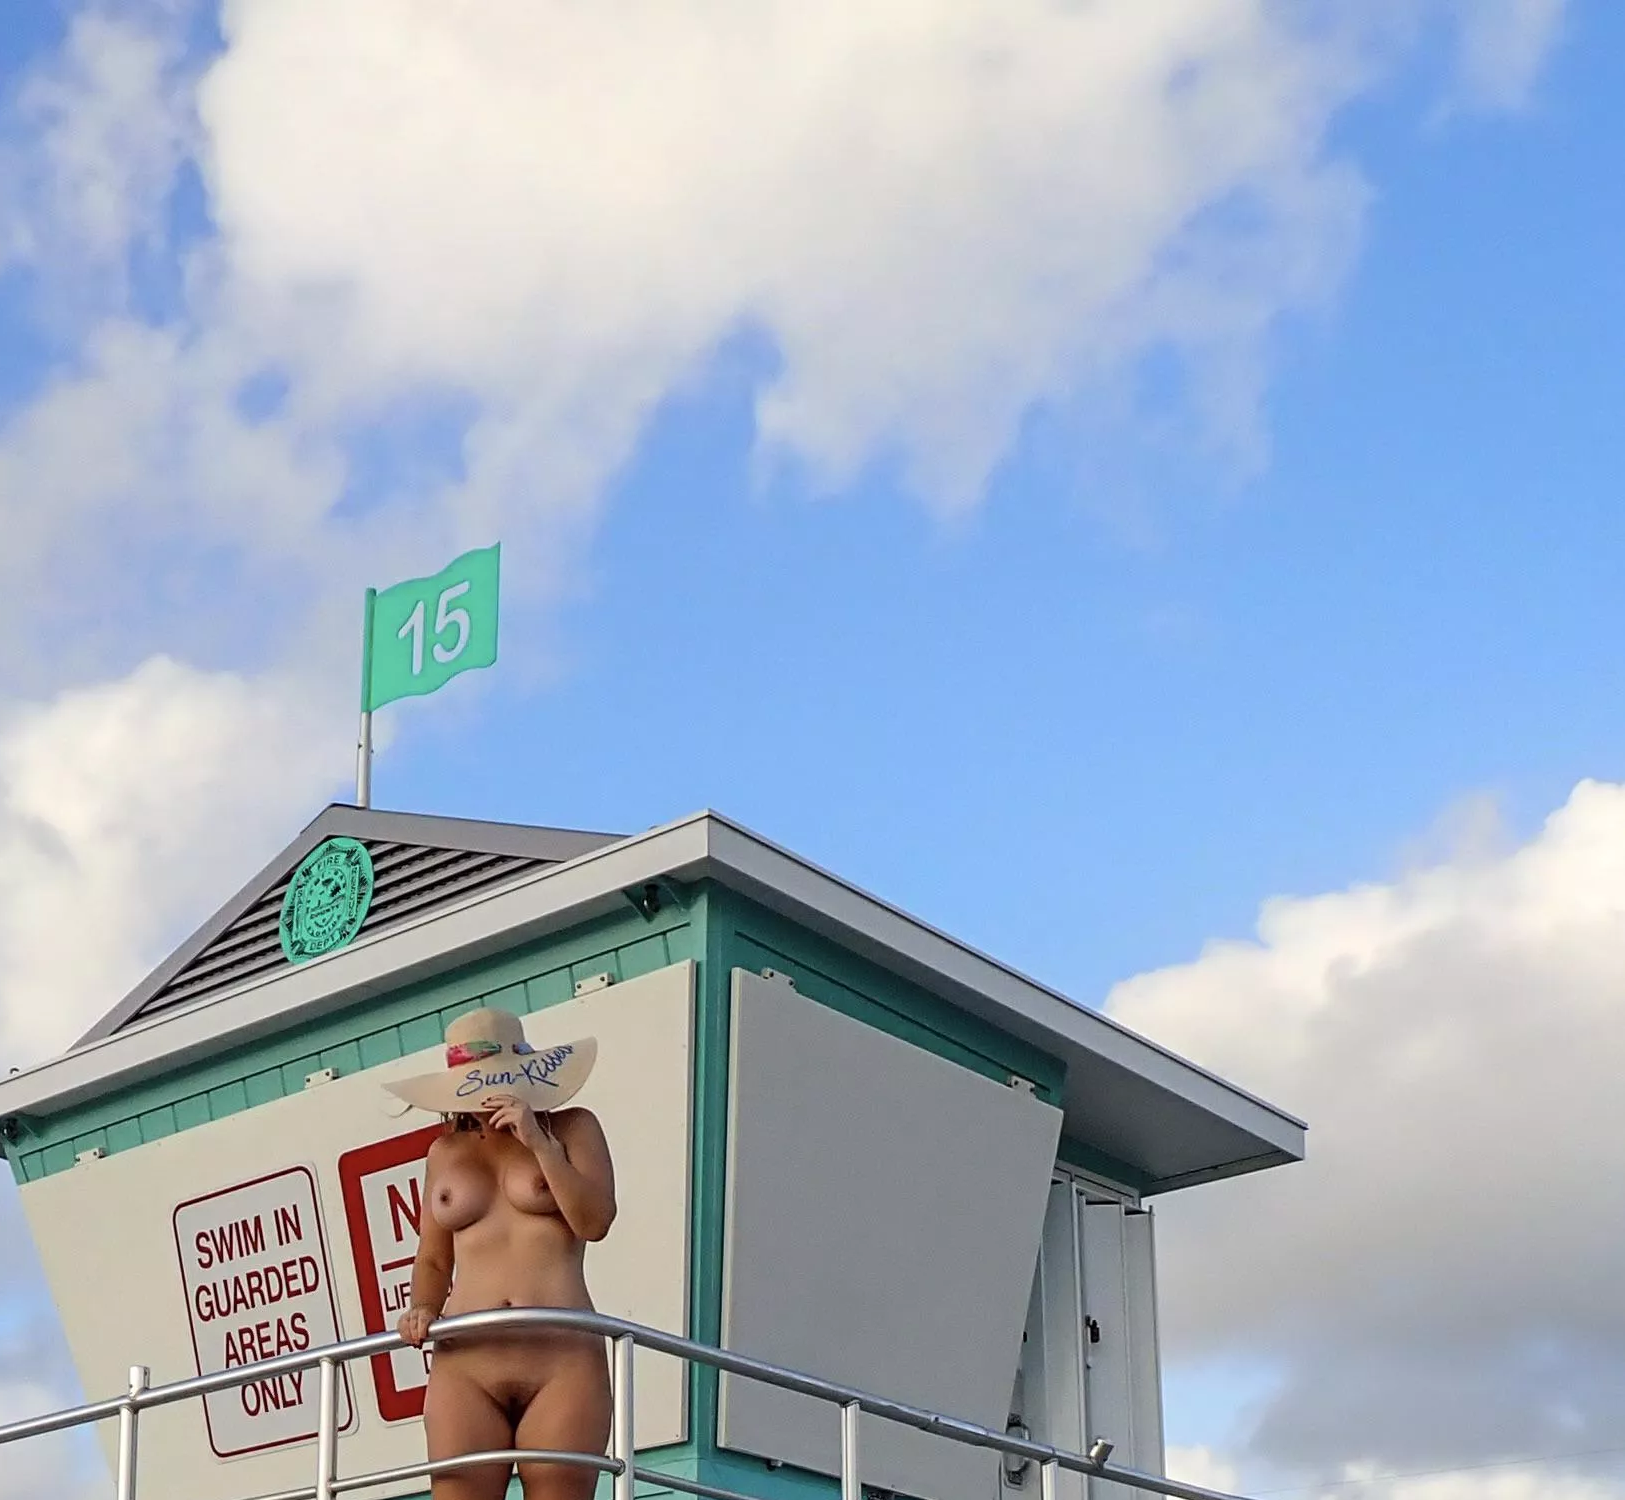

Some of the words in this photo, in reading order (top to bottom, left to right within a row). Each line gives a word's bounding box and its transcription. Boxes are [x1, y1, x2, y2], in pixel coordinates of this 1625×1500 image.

[397, 580, 471, 676] 15
[195, 1214, 267, 1269] SWIM
[273, 1204, 304, 1246] IN
[386, 1177, 422, 1243] N
[195, 1255, 320, 1322] GUARDED
[225, 1312, 310, 1369] AREAS
[240, 1369, 304, 1417] ONLY
